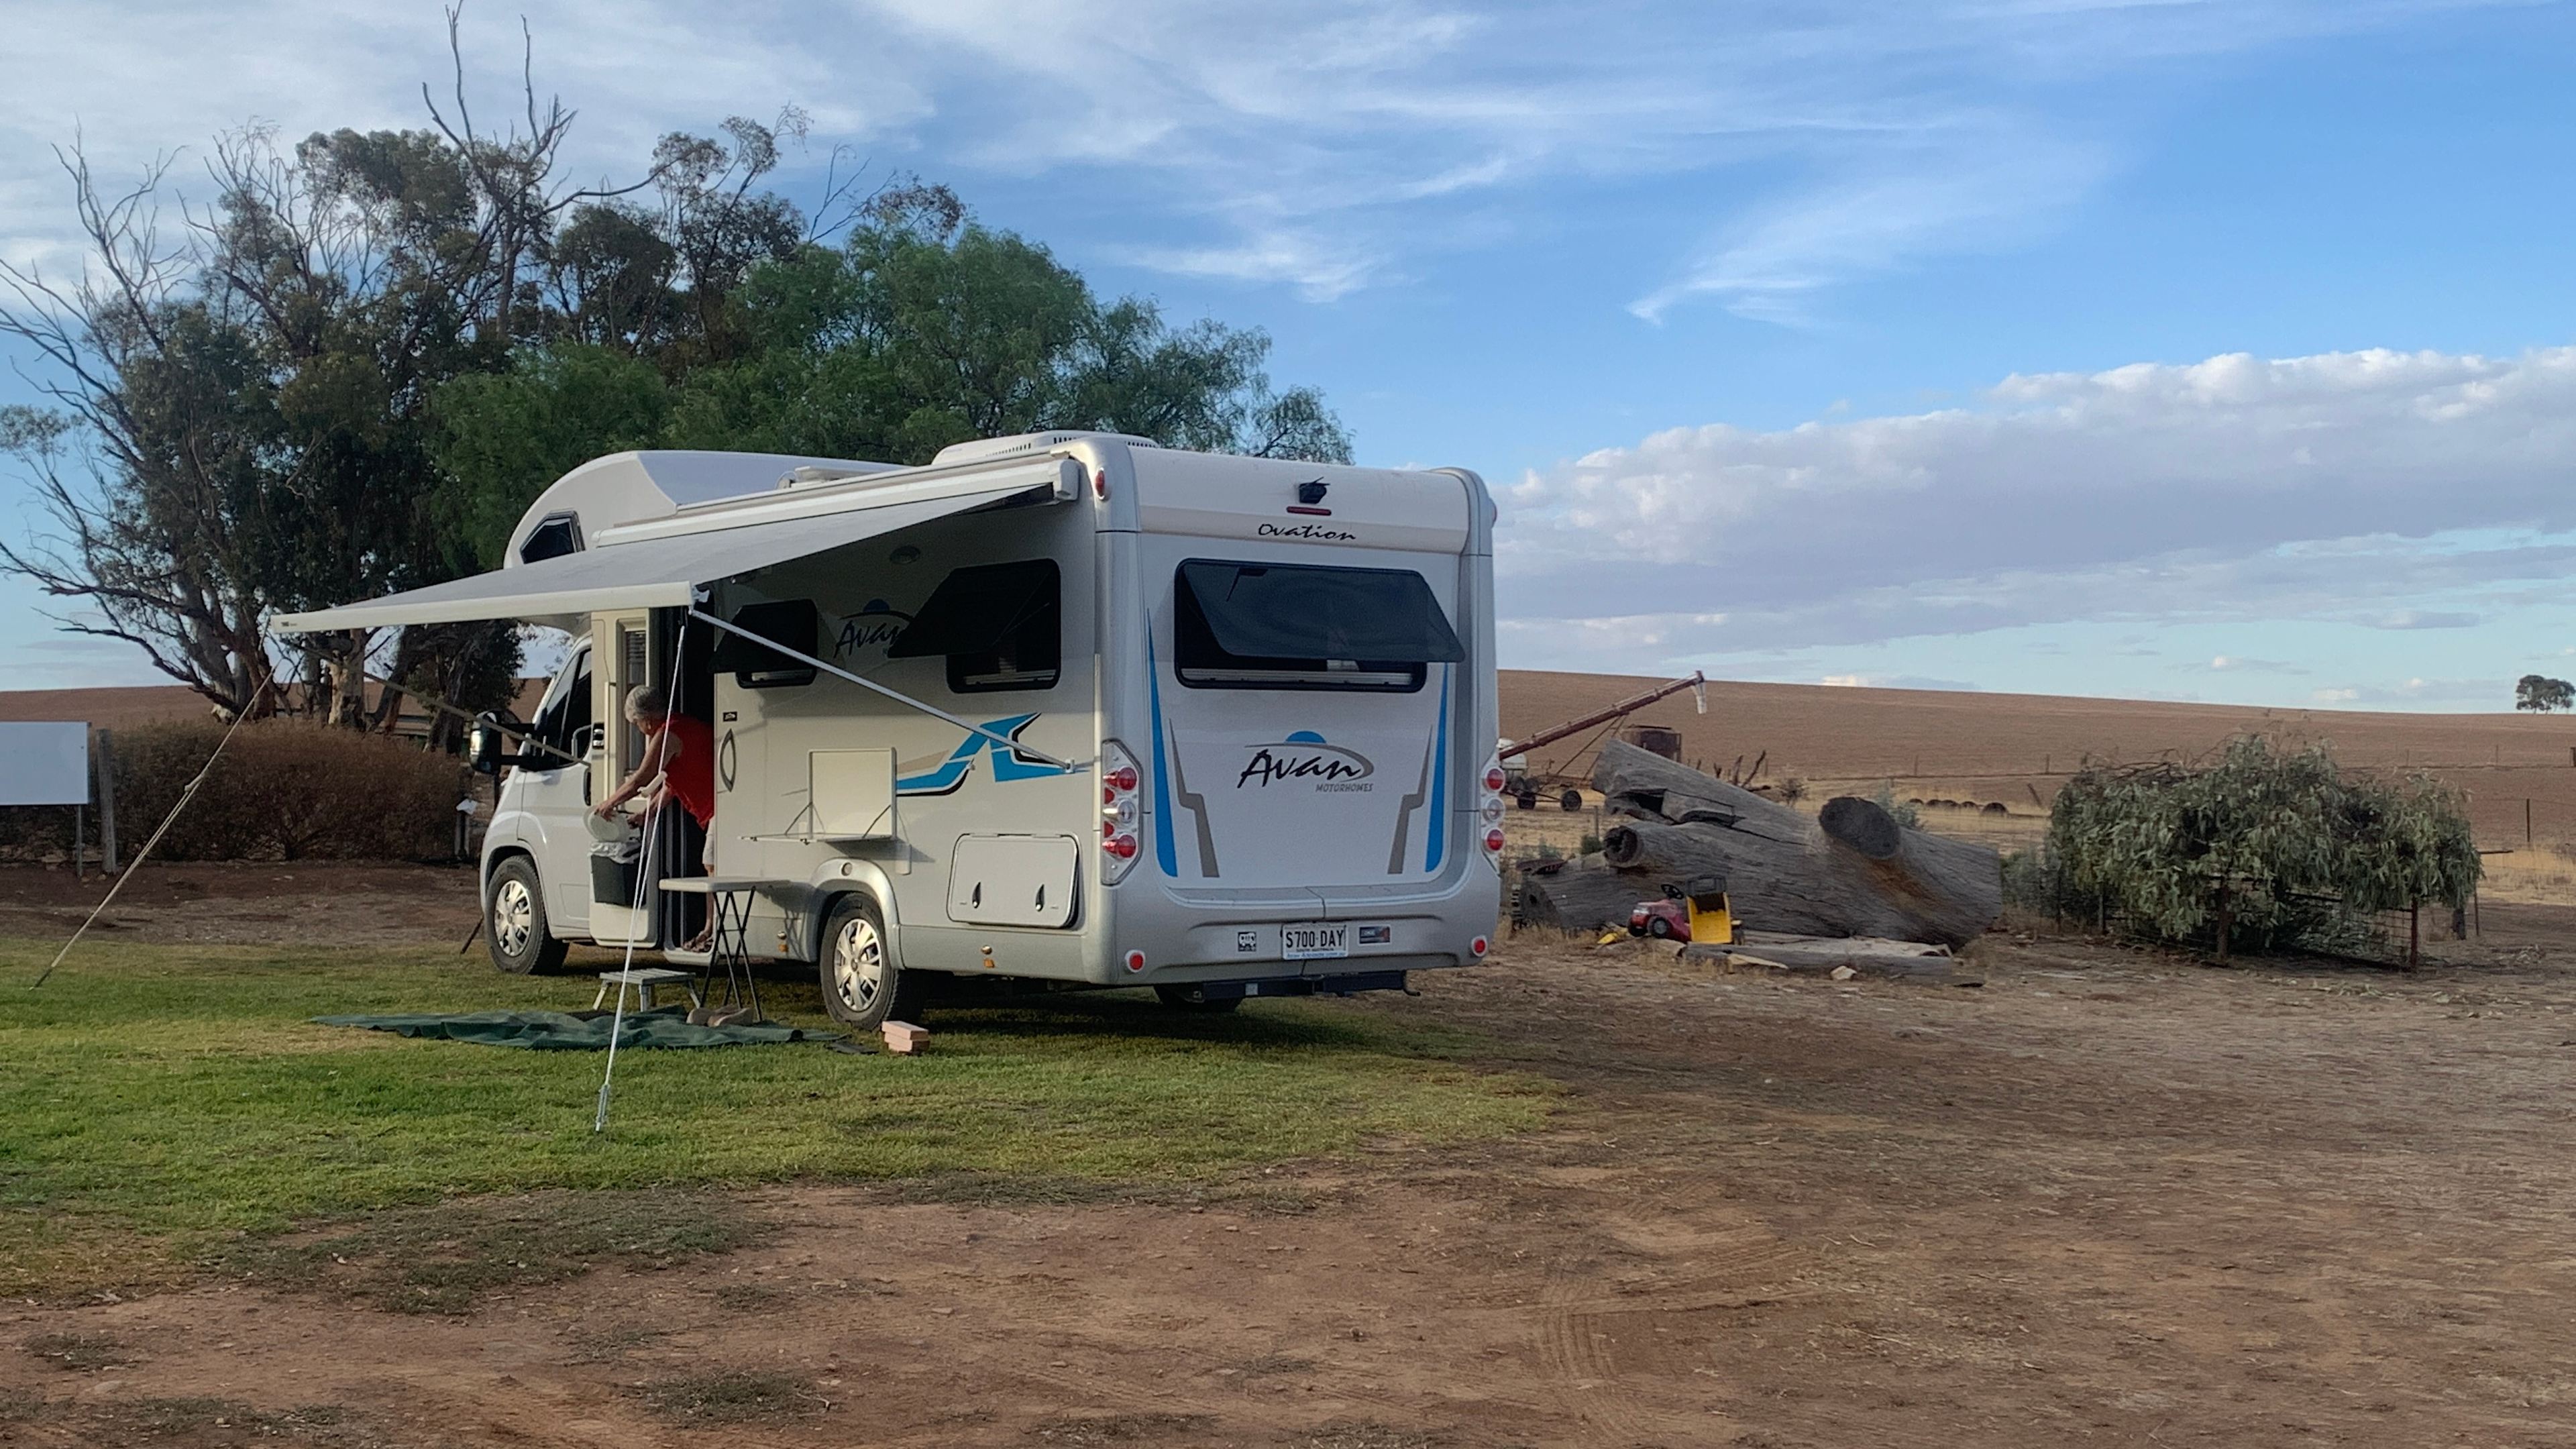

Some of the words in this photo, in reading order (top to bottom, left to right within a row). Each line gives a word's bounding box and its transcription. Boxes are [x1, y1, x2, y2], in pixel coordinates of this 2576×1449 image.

[1258, 523, 1356, 541] Ovation
[1237, 748, 1362, 789] Avan
[1315, 783, 1375, 792] MOTORHOMES
